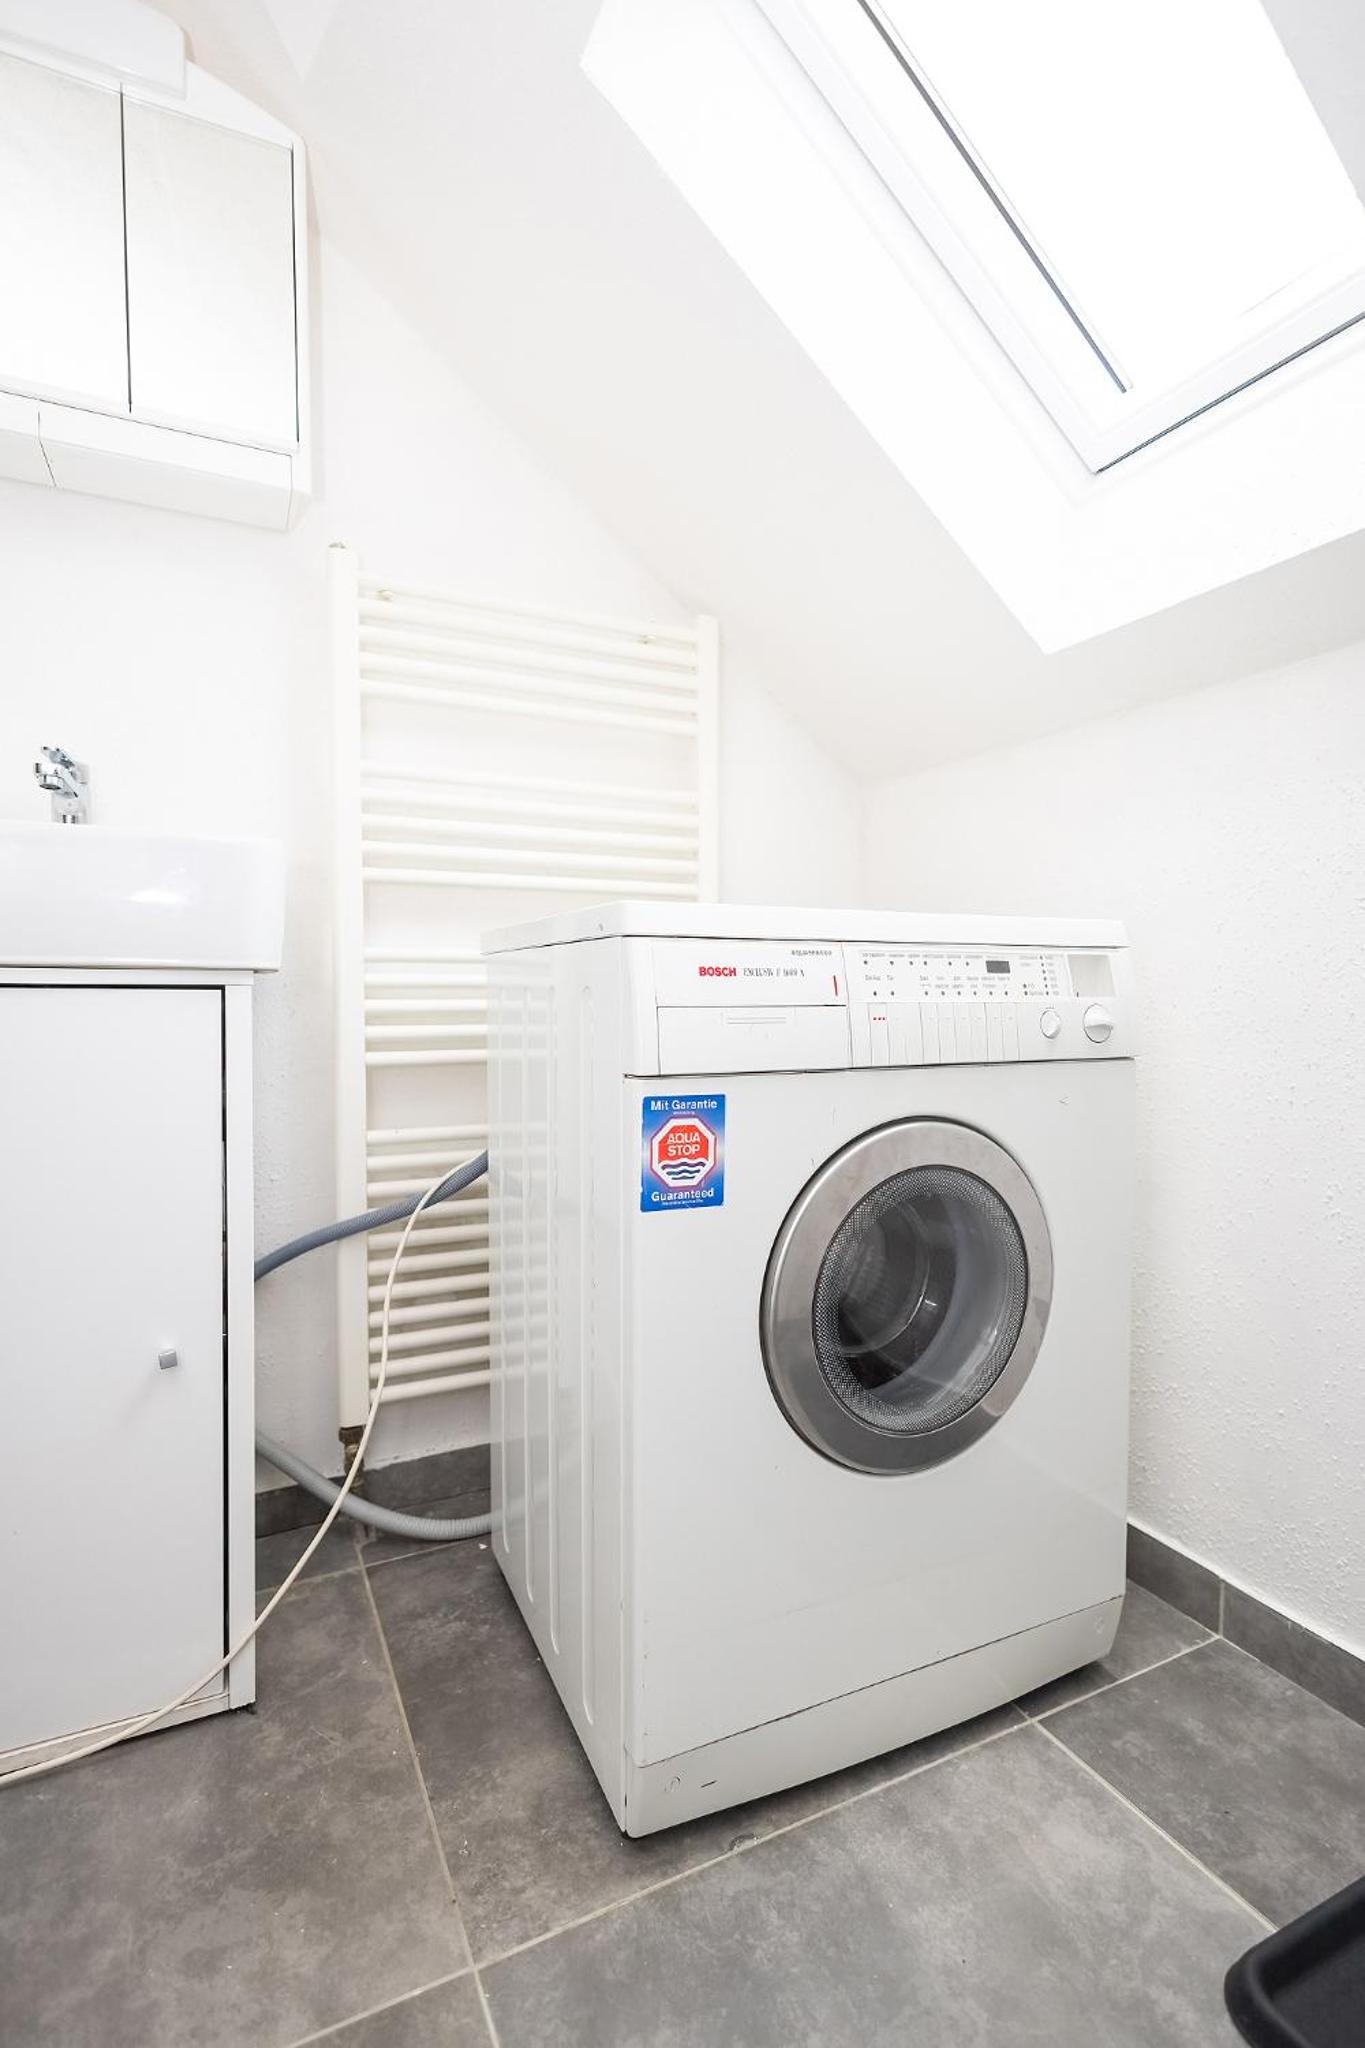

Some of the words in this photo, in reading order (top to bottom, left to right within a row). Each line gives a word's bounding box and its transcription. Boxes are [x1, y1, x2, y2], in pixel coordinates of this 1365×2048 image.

[699, 966, 737, 977] BOSCH
[651, 1101, 669, 1111] Mit
[672, 1099, 718, 1110] Garantie
[667, 1133, 700, 1144] AQUA
[667, 1145, 700, 1157] STOP
[651, 1187, 715, 1202] Guaranteed
